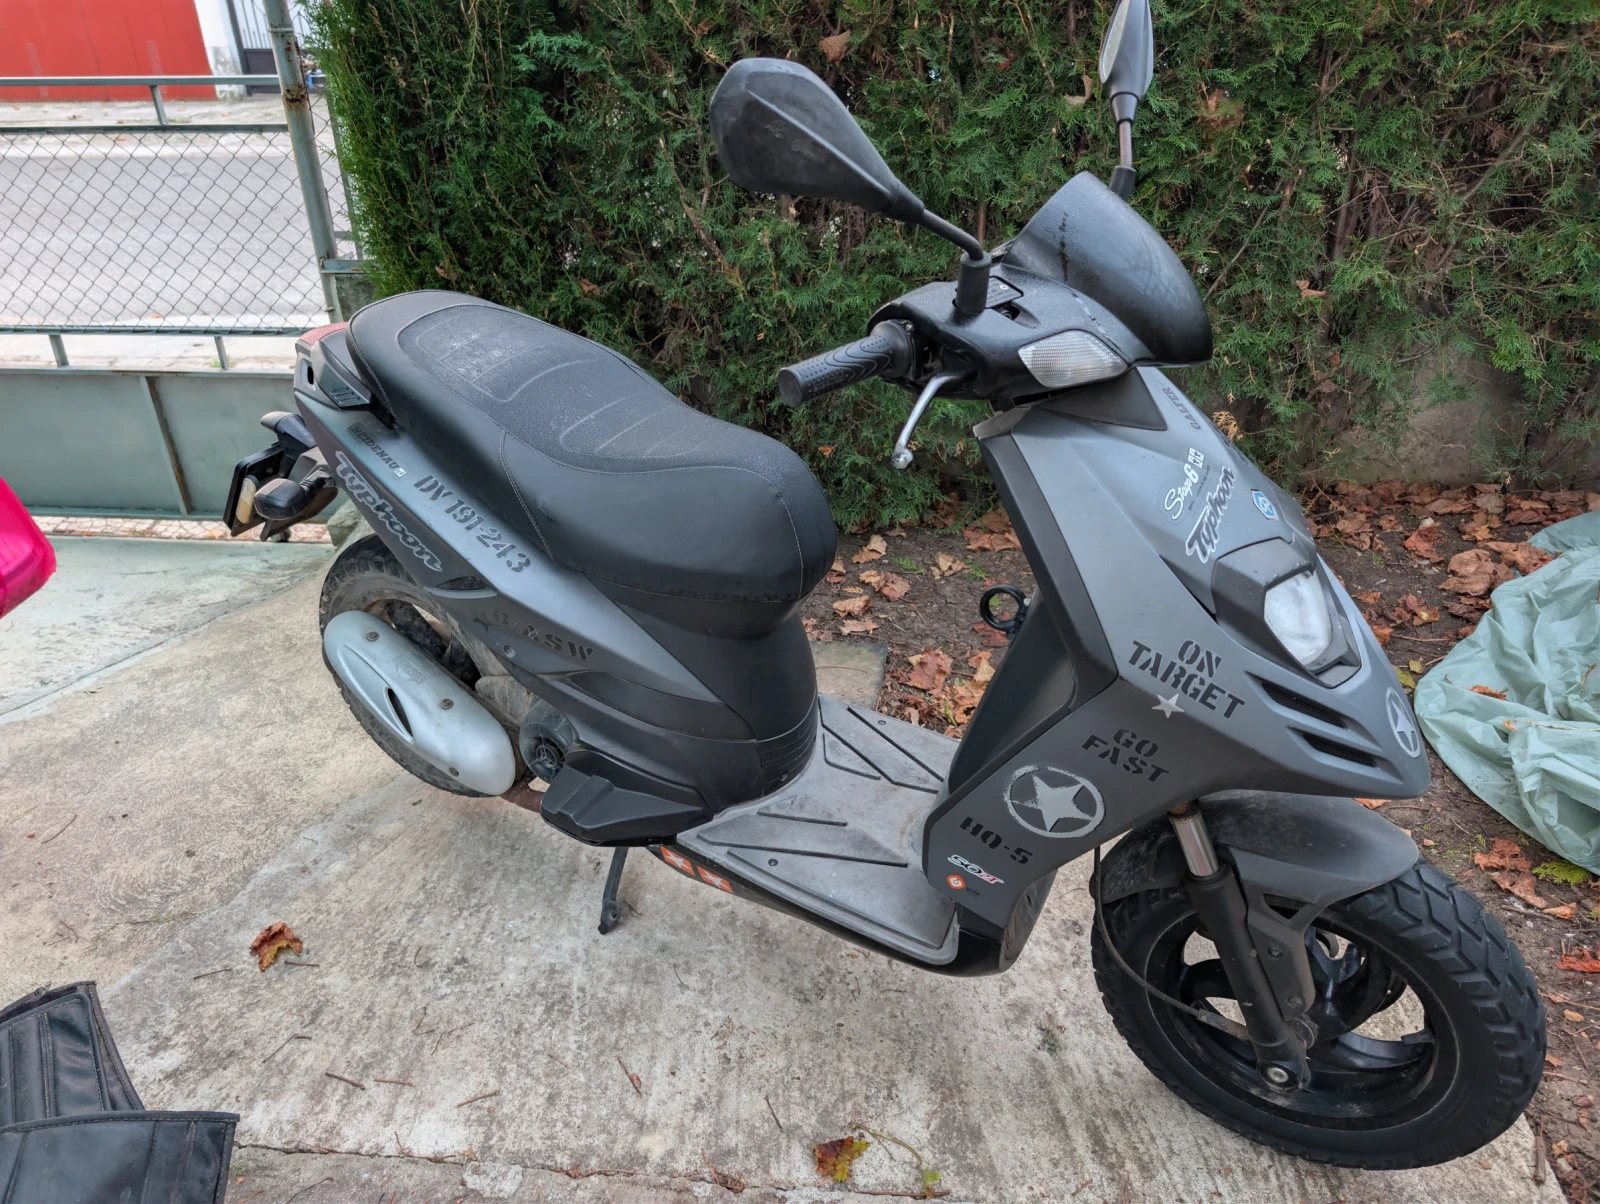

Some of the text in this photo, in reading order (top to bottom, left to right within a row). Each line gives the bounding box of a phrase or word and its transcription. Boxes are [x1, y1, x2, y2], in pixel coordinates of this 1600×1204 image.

[1161, 386, 1202, 430] GALFER
[350, 425, 400, 469] HEIDENAU
[335, 450, 443, 572] Typhoon
[1185, 465, 1236, 564] Typhoon
[444, 498, 531, 573] 191-243
[1128, 639, 1246, 719] TARGET
[1177, 639, 1222, 679] ON
[1081, 734, 1170, 782] FAST
[1112, 727, 1159, 758] GO
